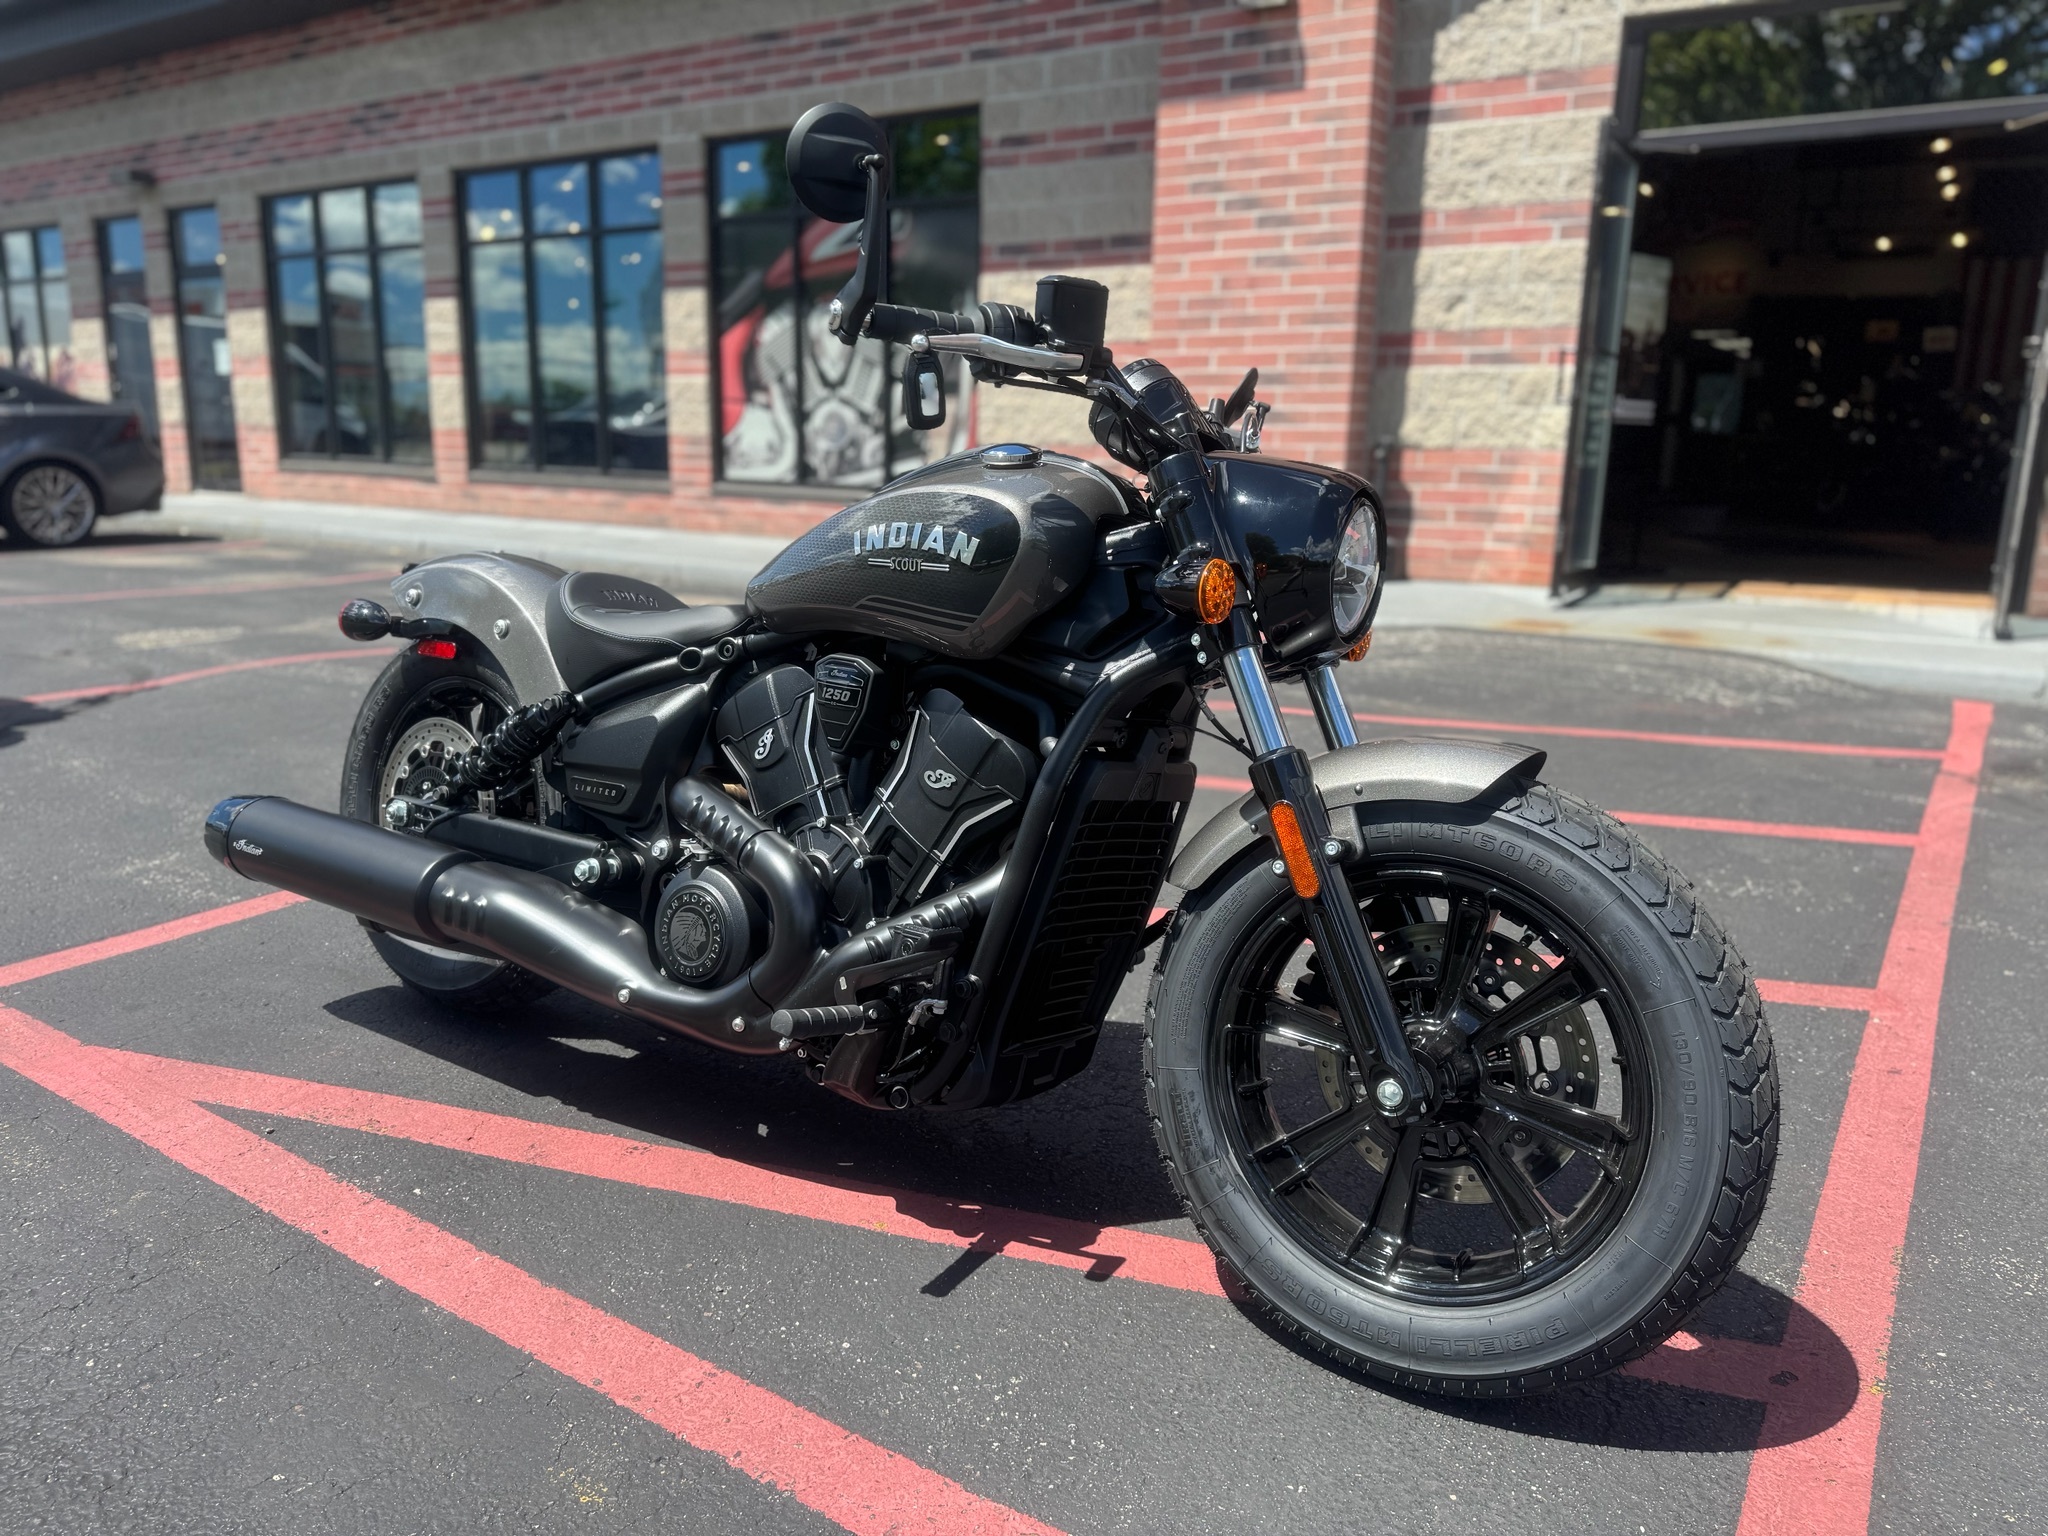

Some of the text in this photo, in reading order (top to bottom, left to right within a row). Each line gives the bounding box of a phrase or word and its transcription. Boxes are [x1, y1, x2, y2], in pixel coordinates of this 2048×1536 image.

[853, 521, 981, 566] INDIAN
[889, 556, 923, 572] SCOUT
[821, 686, 851, 702] 1250
[574, 783, 617, 797] LIMITED
[661, 894, 721, 968] INDIAN MOTORCYCLE
[1671, 1030, 1698, 1107] 130/90
[1653, 1201, 1681, 1241] 67H
[1416, 1317, 1569, 1357] PIRELLI
